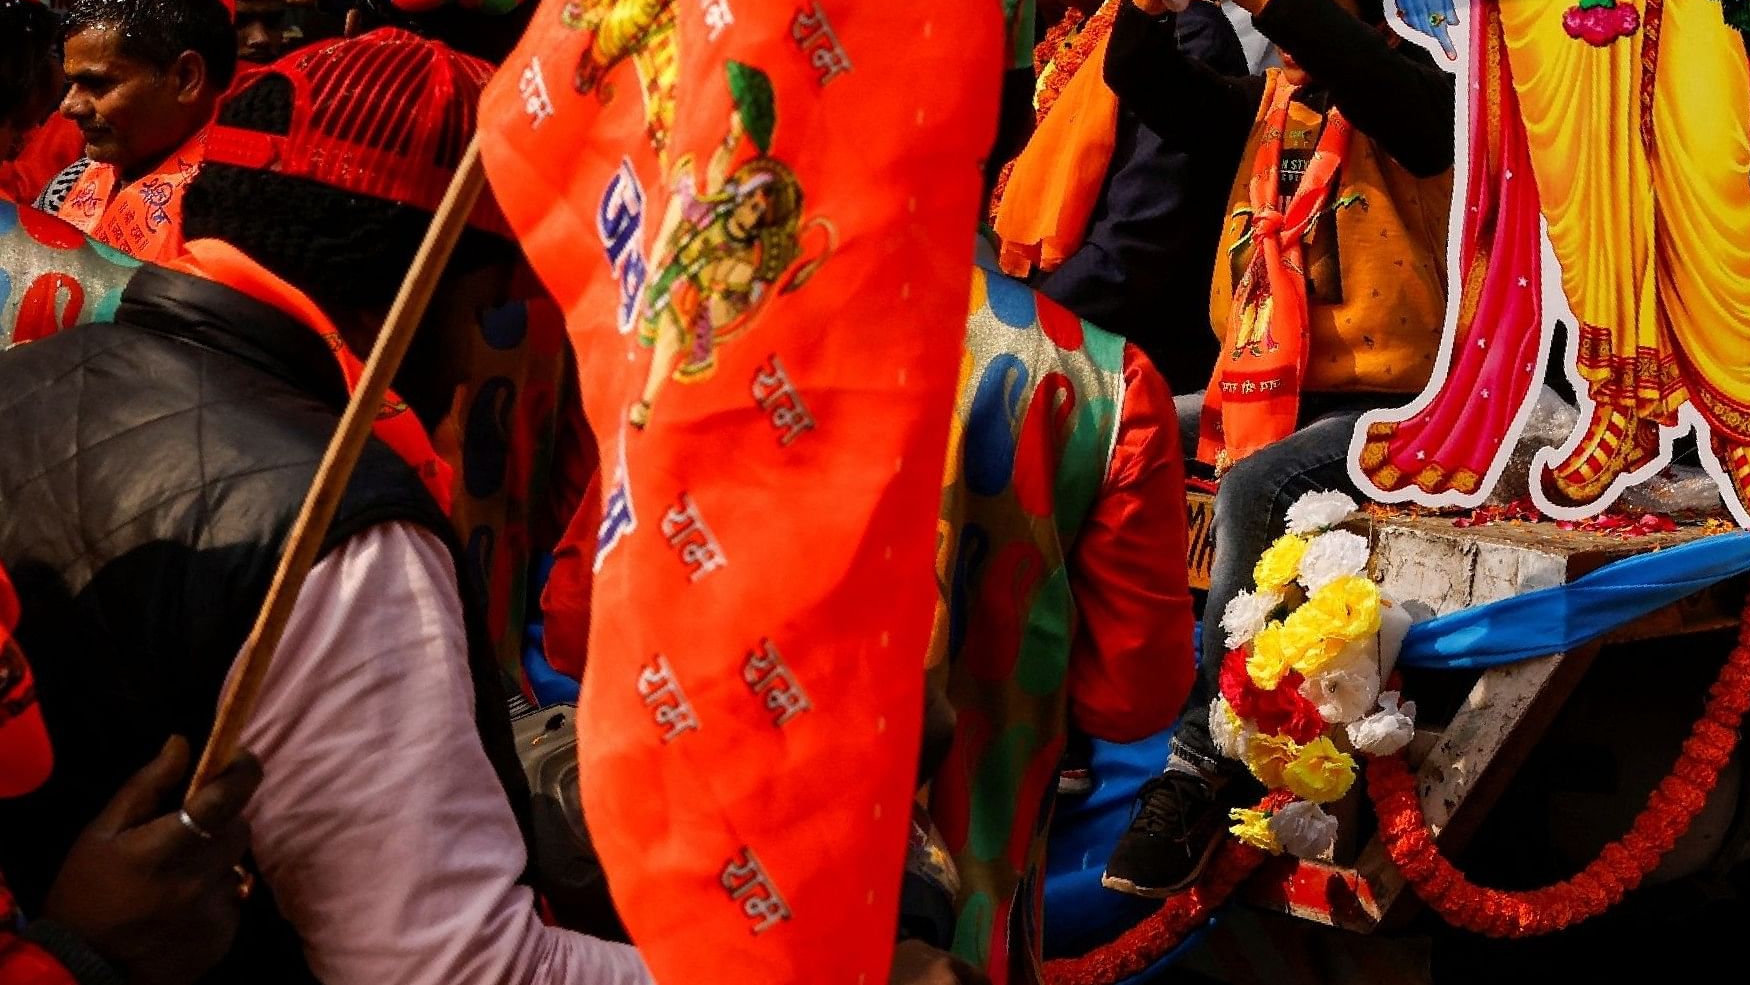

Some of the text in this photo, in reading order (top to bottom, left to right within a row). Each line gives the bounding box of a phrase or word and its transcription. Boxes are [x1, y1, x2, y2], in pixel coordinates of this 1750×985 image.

[517, 56, 555, 131] राम
[751, 352, 816, 448] राम
[660, 491, 728, 584] राम
[636, 652, 701, 746] राम
[740, 635, 814, 730] राम
[720, 844, 793, 935] राम
